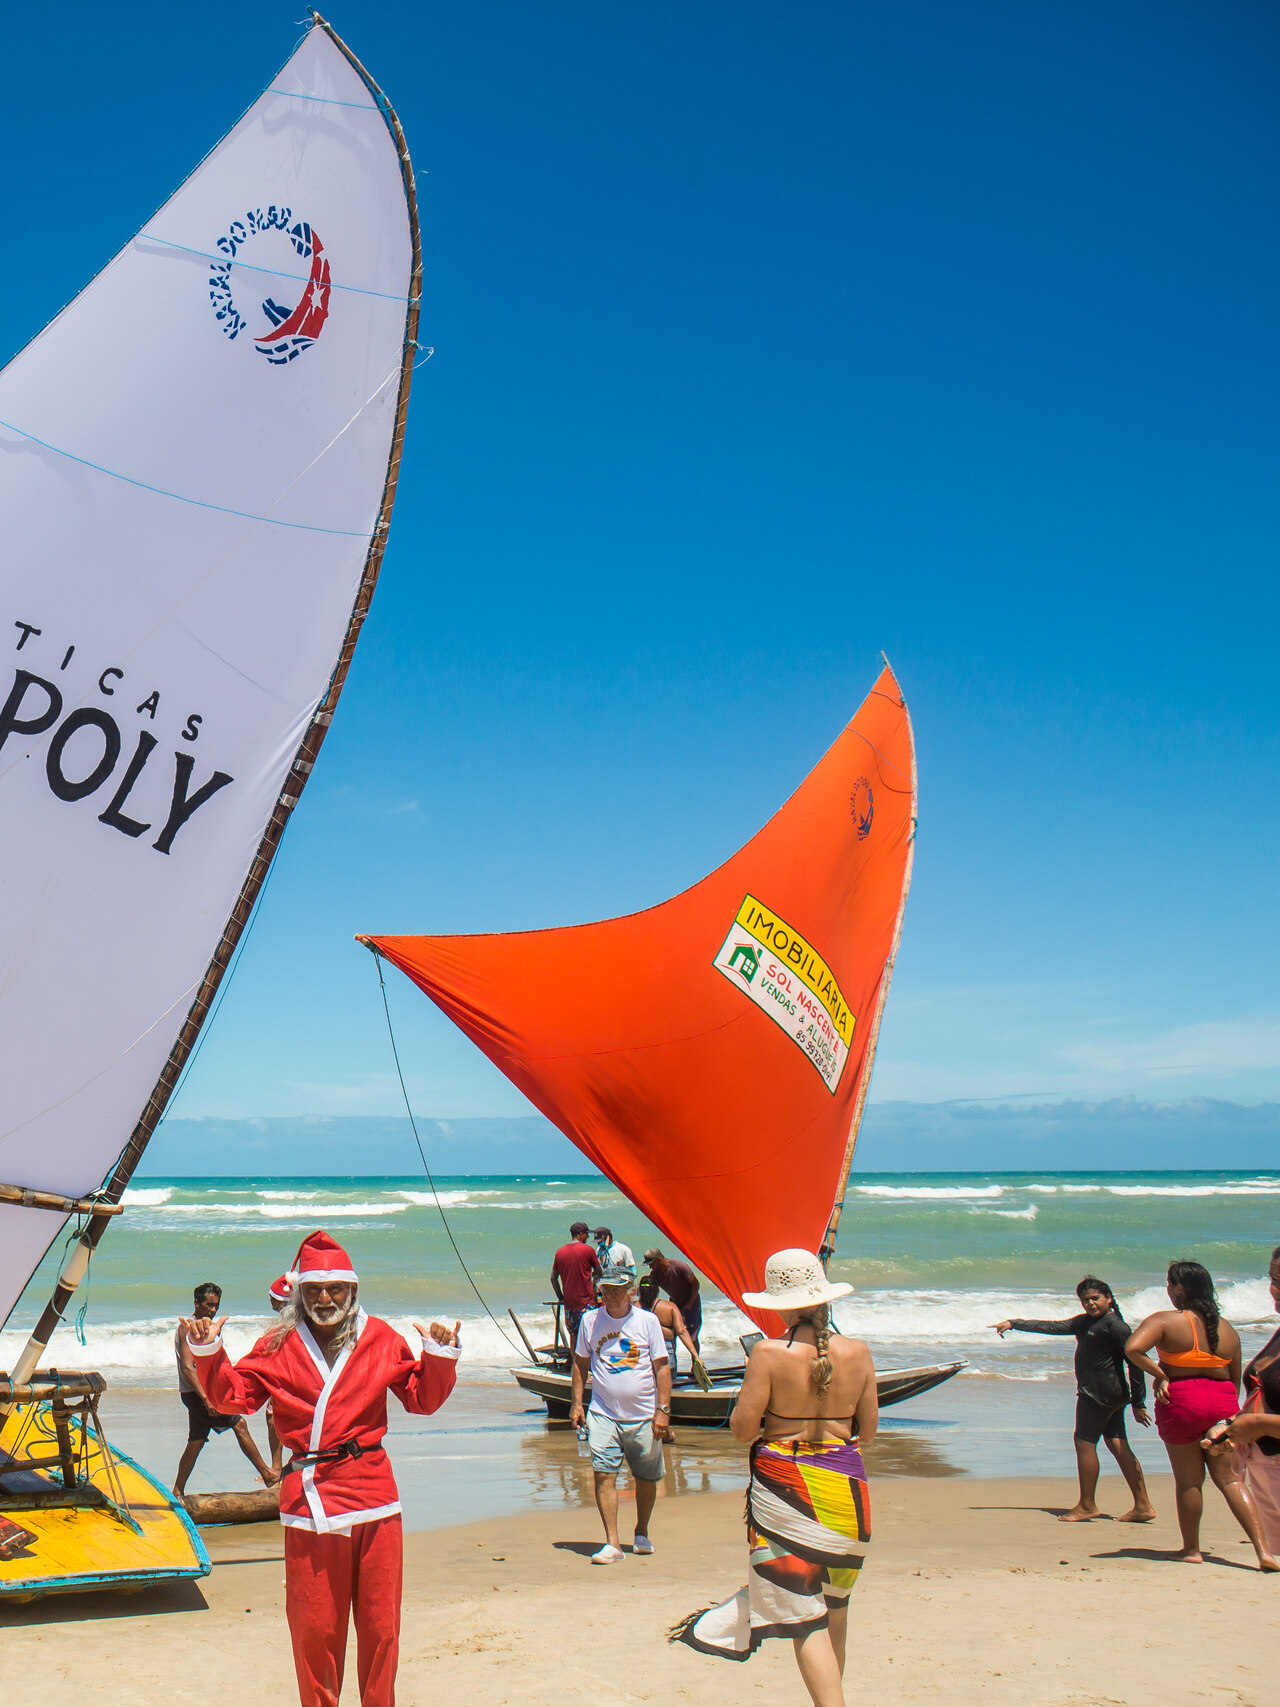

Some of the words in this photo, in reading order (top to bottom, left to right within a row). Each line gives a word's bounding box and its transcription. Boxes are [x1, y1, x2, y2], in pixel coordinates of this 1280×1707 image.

[746, 907, 847, 1033] IMOBILIÁRIA
[766, 964, 792, 994] SOL
[761, 977, 797, 1016] VENDAS
[796, 1029, 808, 1043] 85
